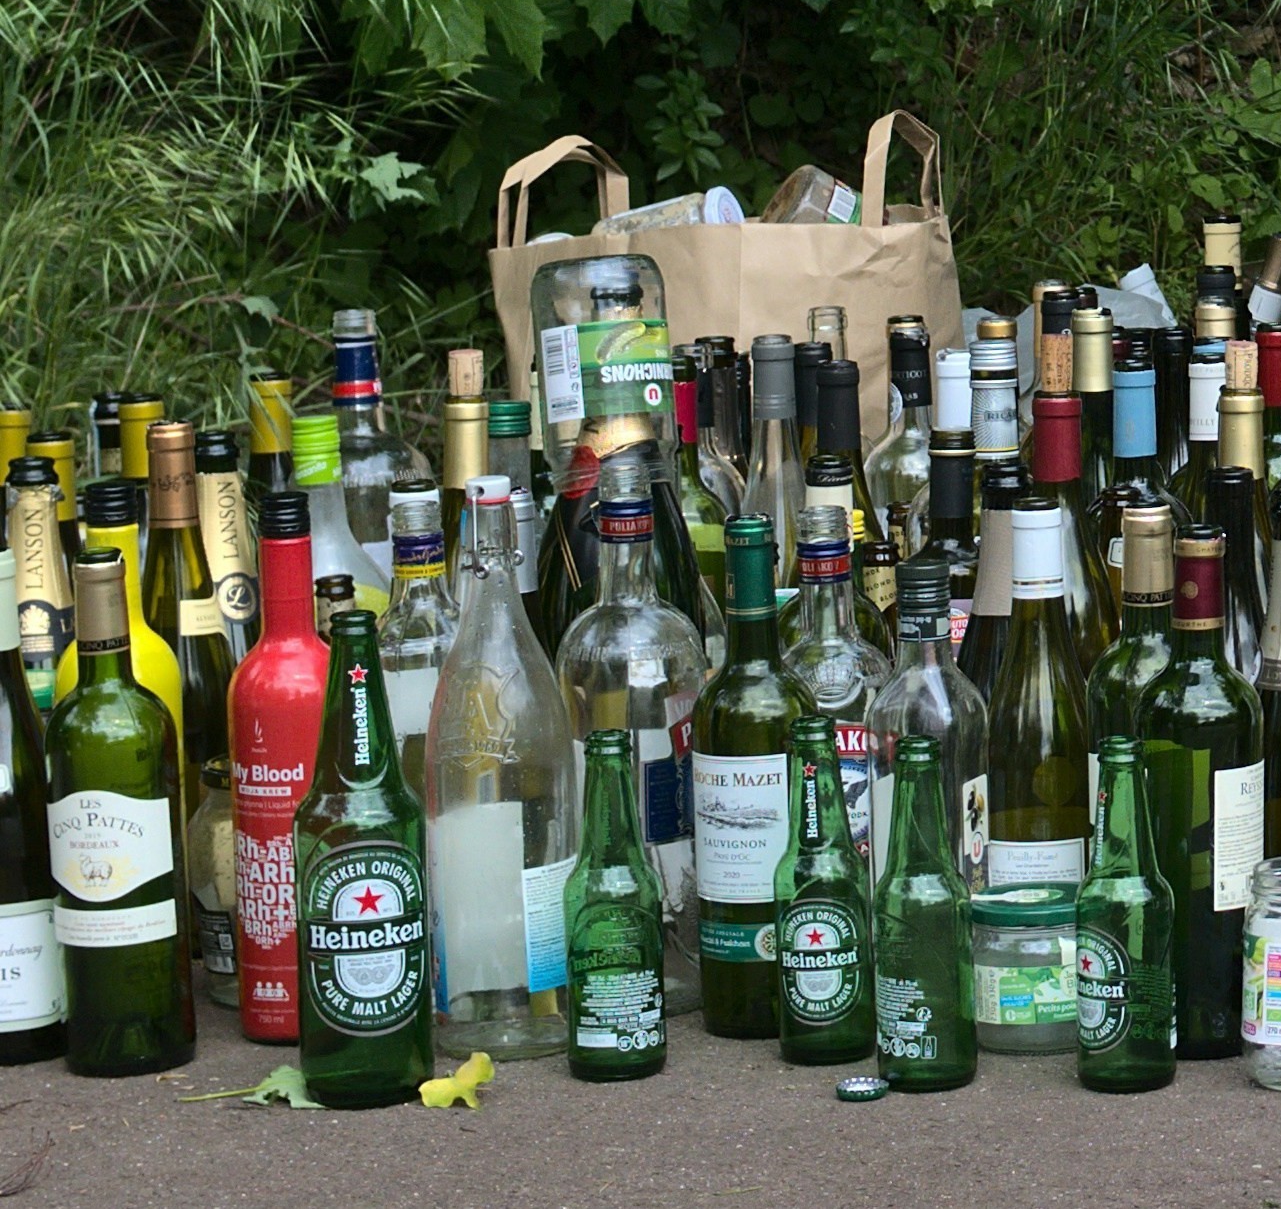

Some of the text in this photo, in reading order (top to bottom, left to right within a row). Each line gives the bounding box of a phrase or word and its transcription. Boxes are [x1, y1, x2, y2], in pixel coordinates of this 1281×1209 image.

[216, 481, 240, 559] LANSON
[23, 508, 44, 590] LANSON
[351, 686, 370, 766] Heineken
[251, 762, 305, 783] Blood
[732, 772, 783, 787] MAZET
[80, 798, 102, 809] LES
[806, 780, 820, 839] Heineken
[53, 812, 145, 839] CINQ PATTES
[69, 840, 120, 849] BORDEAUX
[703, 837, 768, 850] SAUVIGNON
[315, 861, 367, 911] HEINEKEN
[371, 860, 416, 902] ORIGINAL
[309, 918, 425, 951] Heineken
[784, 910, 851, 942] HEINEKEN ORIGINAL
[781, 947, 858, 969] Heineken
[321, 978, 349, 1012] PURE
[352, 1000, 388, 1018] MALT
[390, 969, 419, 1006] LAGER
[787, 982, 853, 1013] PURE MALT LAGER
[1037, 1004, 1061, 1014] Petits
[1096, 1016, 1118, 1039] LAGER
